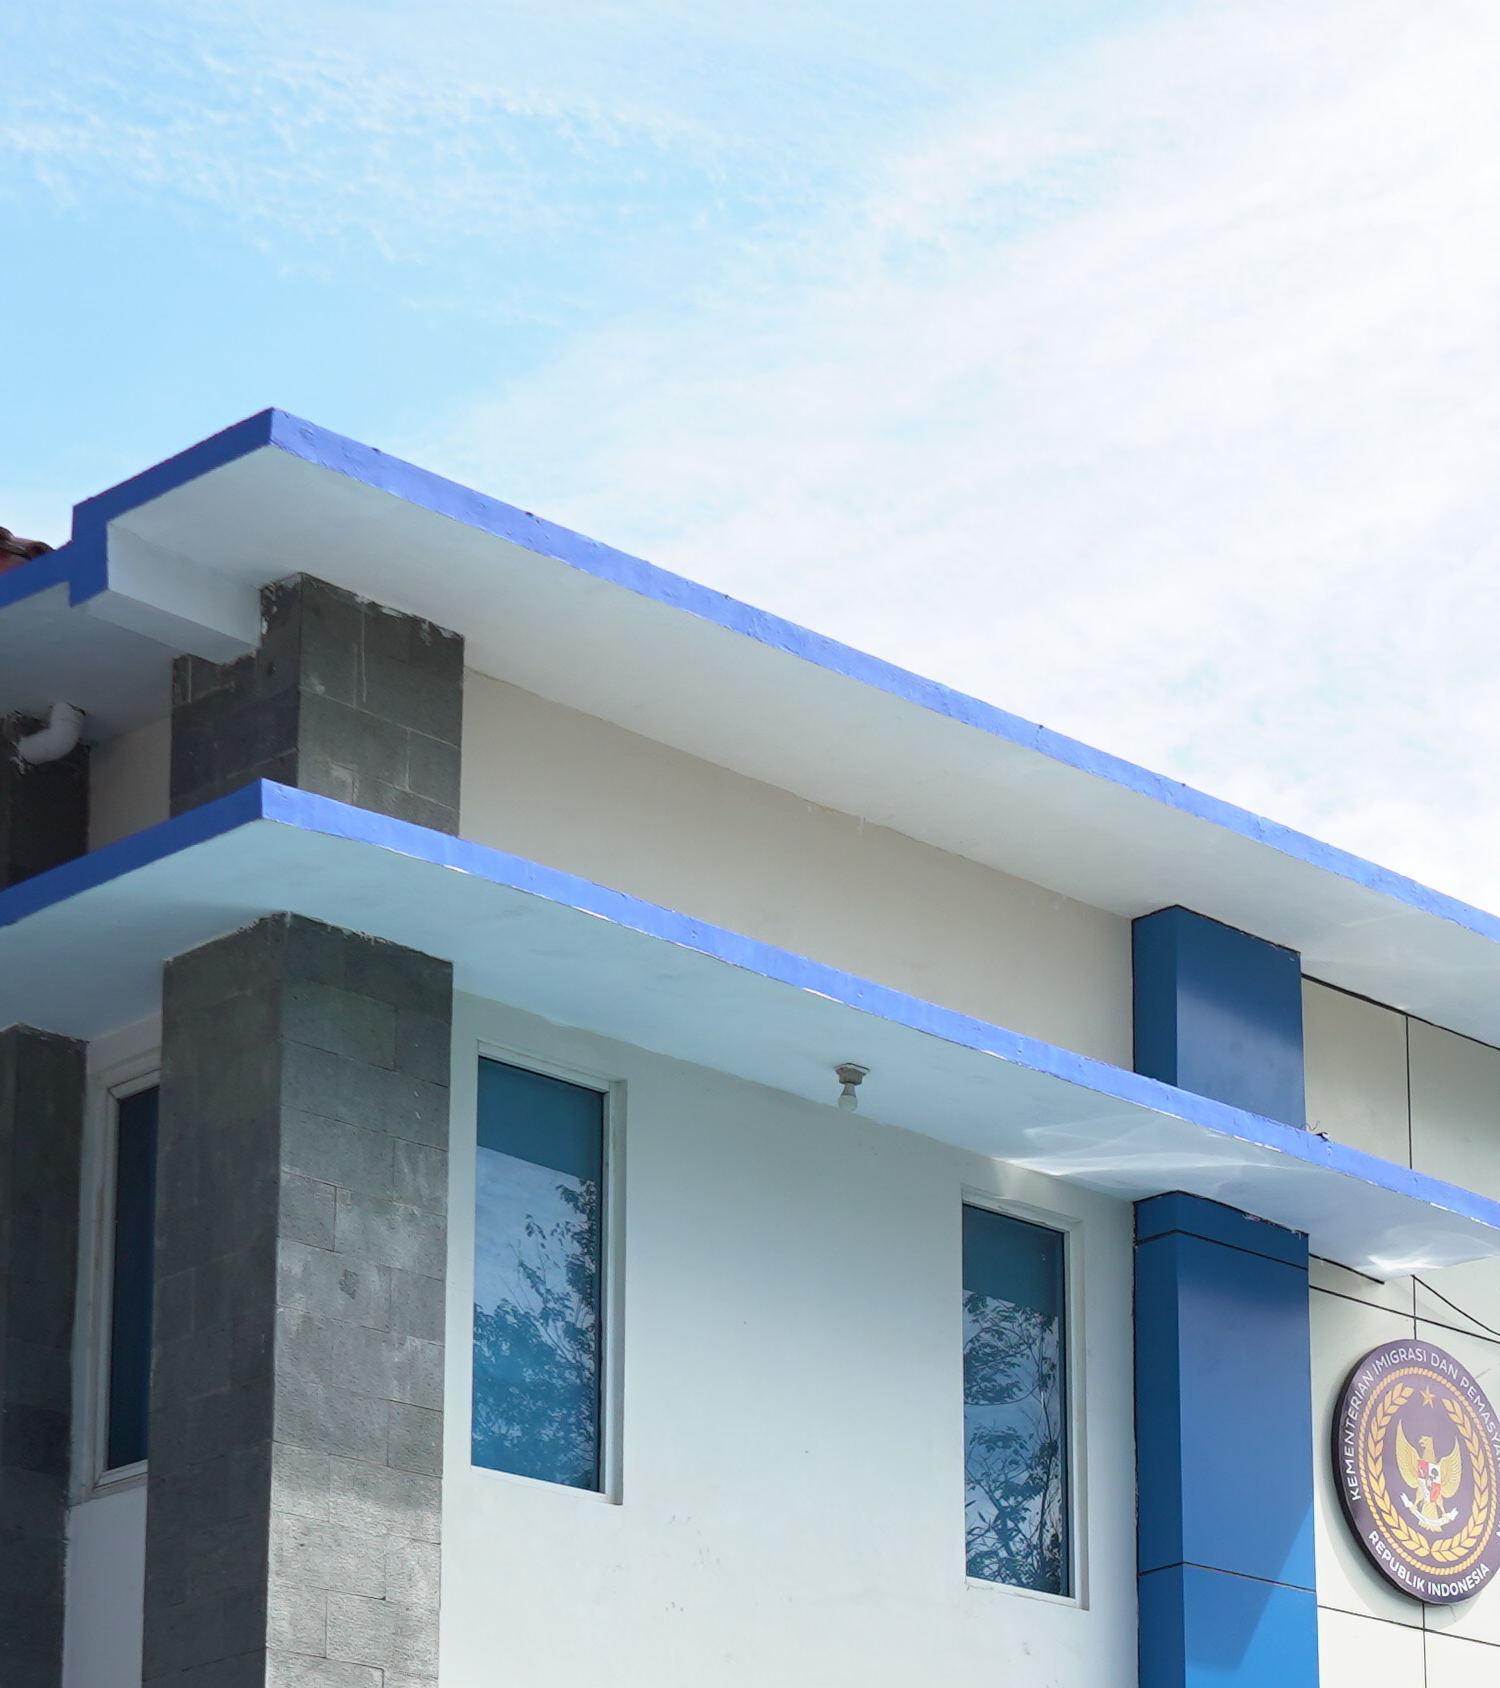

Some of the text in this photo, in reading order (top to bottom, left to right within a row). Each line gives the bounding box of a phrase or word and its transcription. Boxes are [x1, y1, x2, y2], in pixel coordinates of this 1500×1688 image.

[1344, 1371, 1374, 1500] KEMENTERIAN
[1371, 1347, 1427, 1376] IMIGRASI
[1431, 1352, 1458, 1379] DAN
[1368, 1531, 1490, 1597] REPUBLIK INDONESIA
